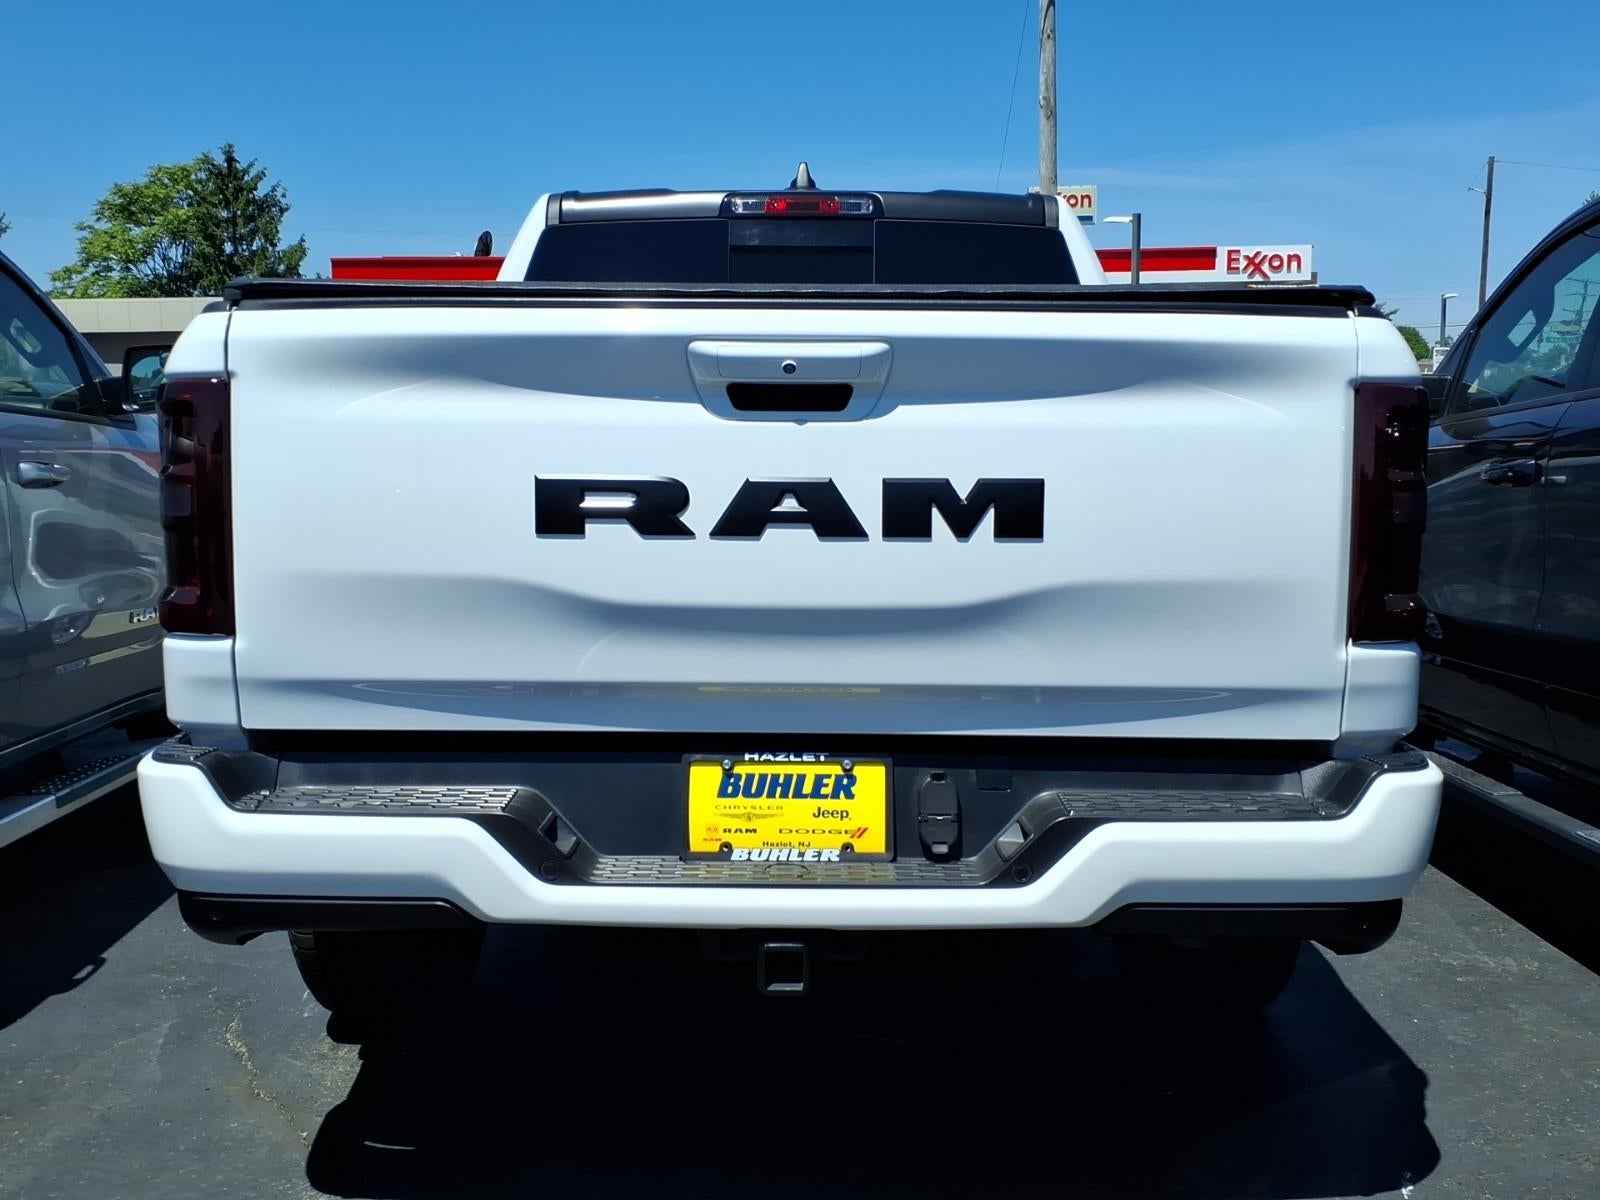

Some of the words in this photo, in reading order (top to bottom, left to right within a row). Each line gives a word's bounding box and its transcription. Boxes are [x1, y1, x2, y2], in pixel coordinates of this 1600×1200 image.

[1226, 249, 1302, 279] Exxon
[535, 474, 1045, 543] RAM
[744, 752, 829, 762] HAZLET
[717, 773, 857, 800] BUHLER
[812, 806, 850, 821] Jeep
[730, 848, 840, 861] BUHLER
